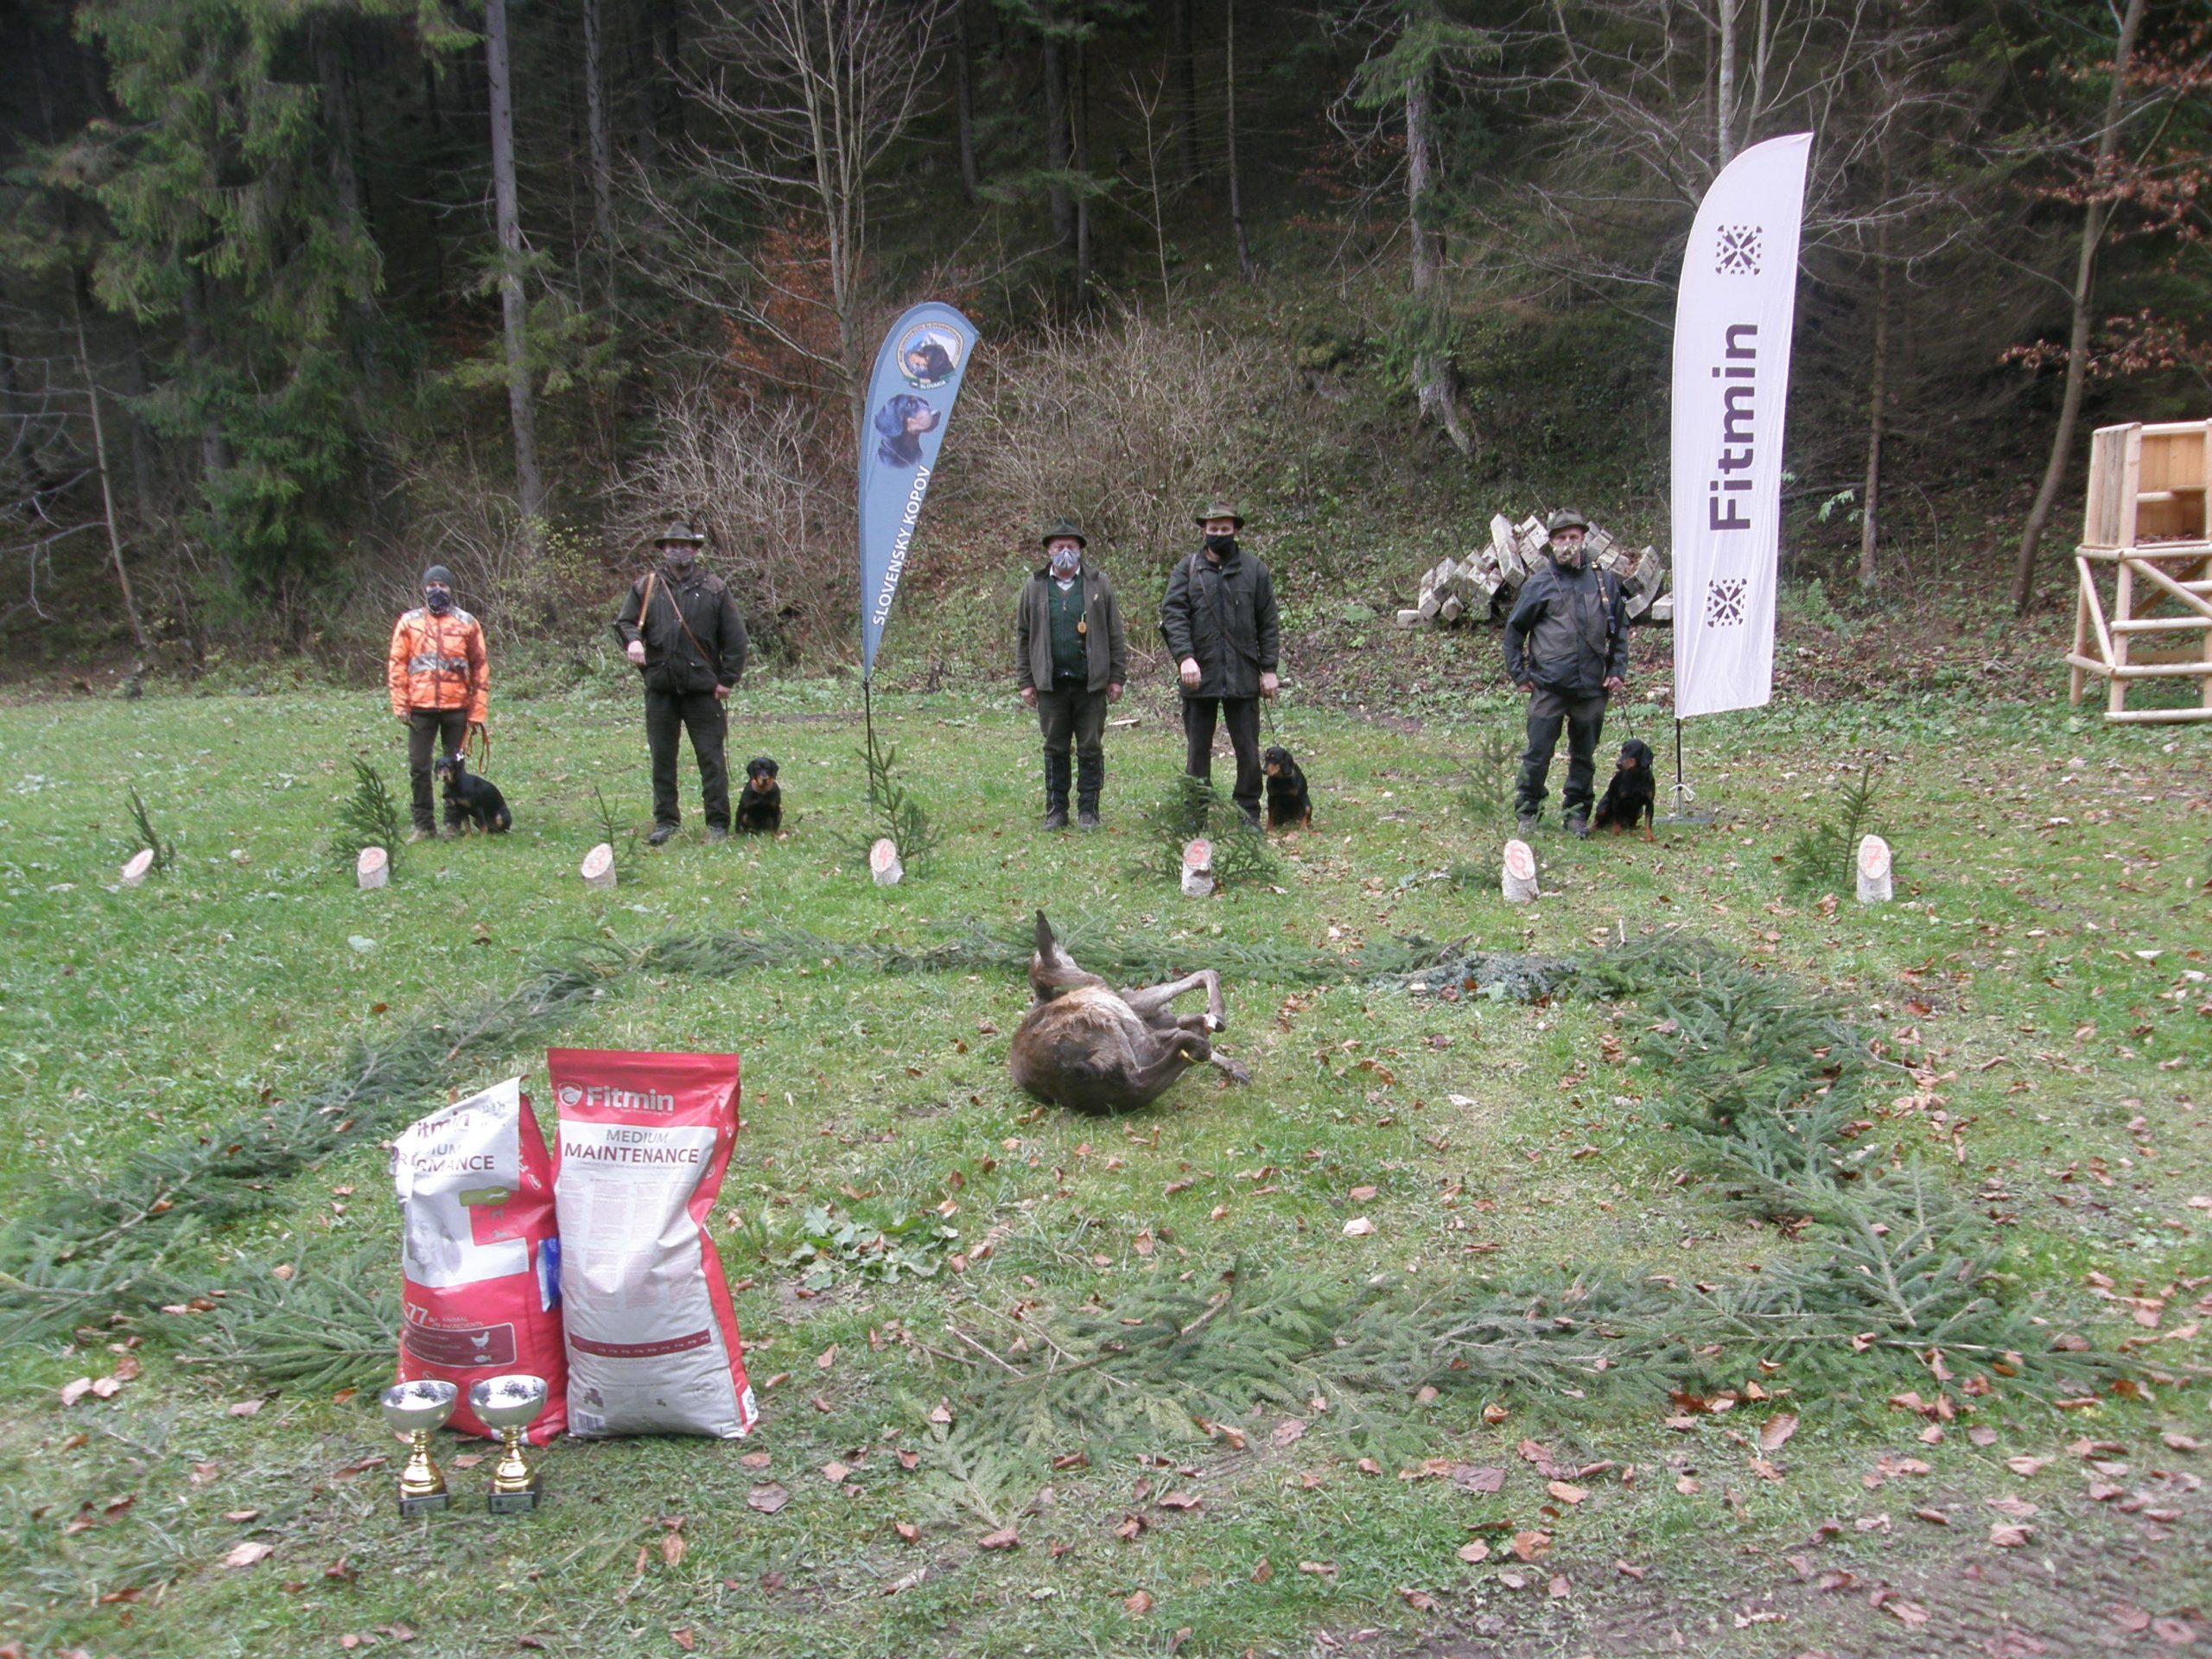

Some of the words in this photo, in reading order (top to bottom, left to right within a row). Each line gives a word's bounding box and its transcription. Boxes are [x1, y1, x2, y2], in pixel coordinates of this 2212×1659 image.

[1710, 324, 1758, 531] Fitmin
[873, 527, 912, 626] SLOVENSKY
[902, 465, 931, 525] KOPOV
[365, 850, 381, 867] 2
[588, 849, 605, 871] 3
[878, 842, 893, 867] 4
[1186, 842, 1206, 864] 5
[1510, 848, 1527, 870] 6
[1865, 844, 1882, 868] 7
[587, 1085, 674, 1112] Fitmin
[607, 1129, 669, 1144] MEDIUM
[564, 1142, 699, 1164] MAINTENANCE
